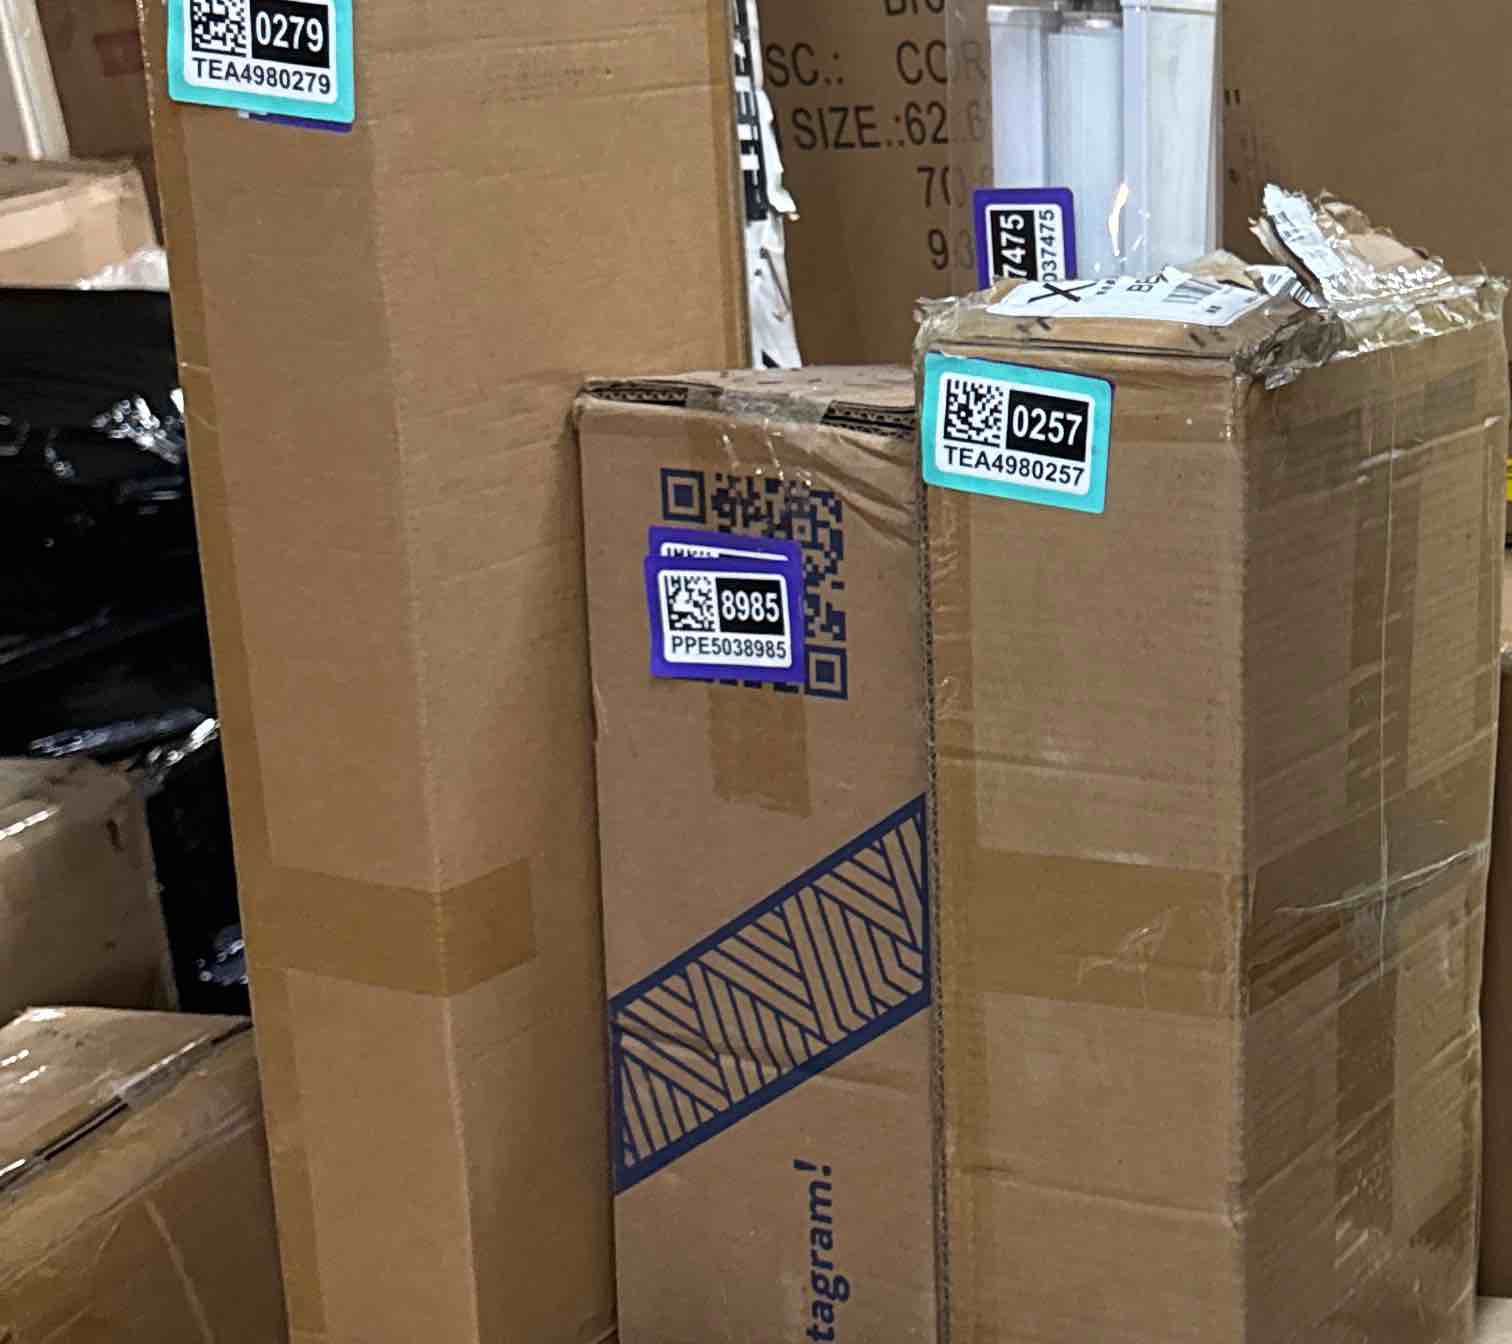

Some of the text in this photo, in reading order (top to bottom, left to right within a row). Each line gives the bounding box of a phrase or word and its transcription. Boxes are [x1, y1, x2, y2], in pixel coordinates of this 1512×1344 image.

[255, 10, 324, 53] 0279
[191, 57, 331, 95] TEA4980279
[1011, 404, 1083, 446] 0257
[943, 444, 1085, 487] TEA4980257
[721, 589, 780, 623] 8985
[671, 634, 787, 659] PPE5038985
